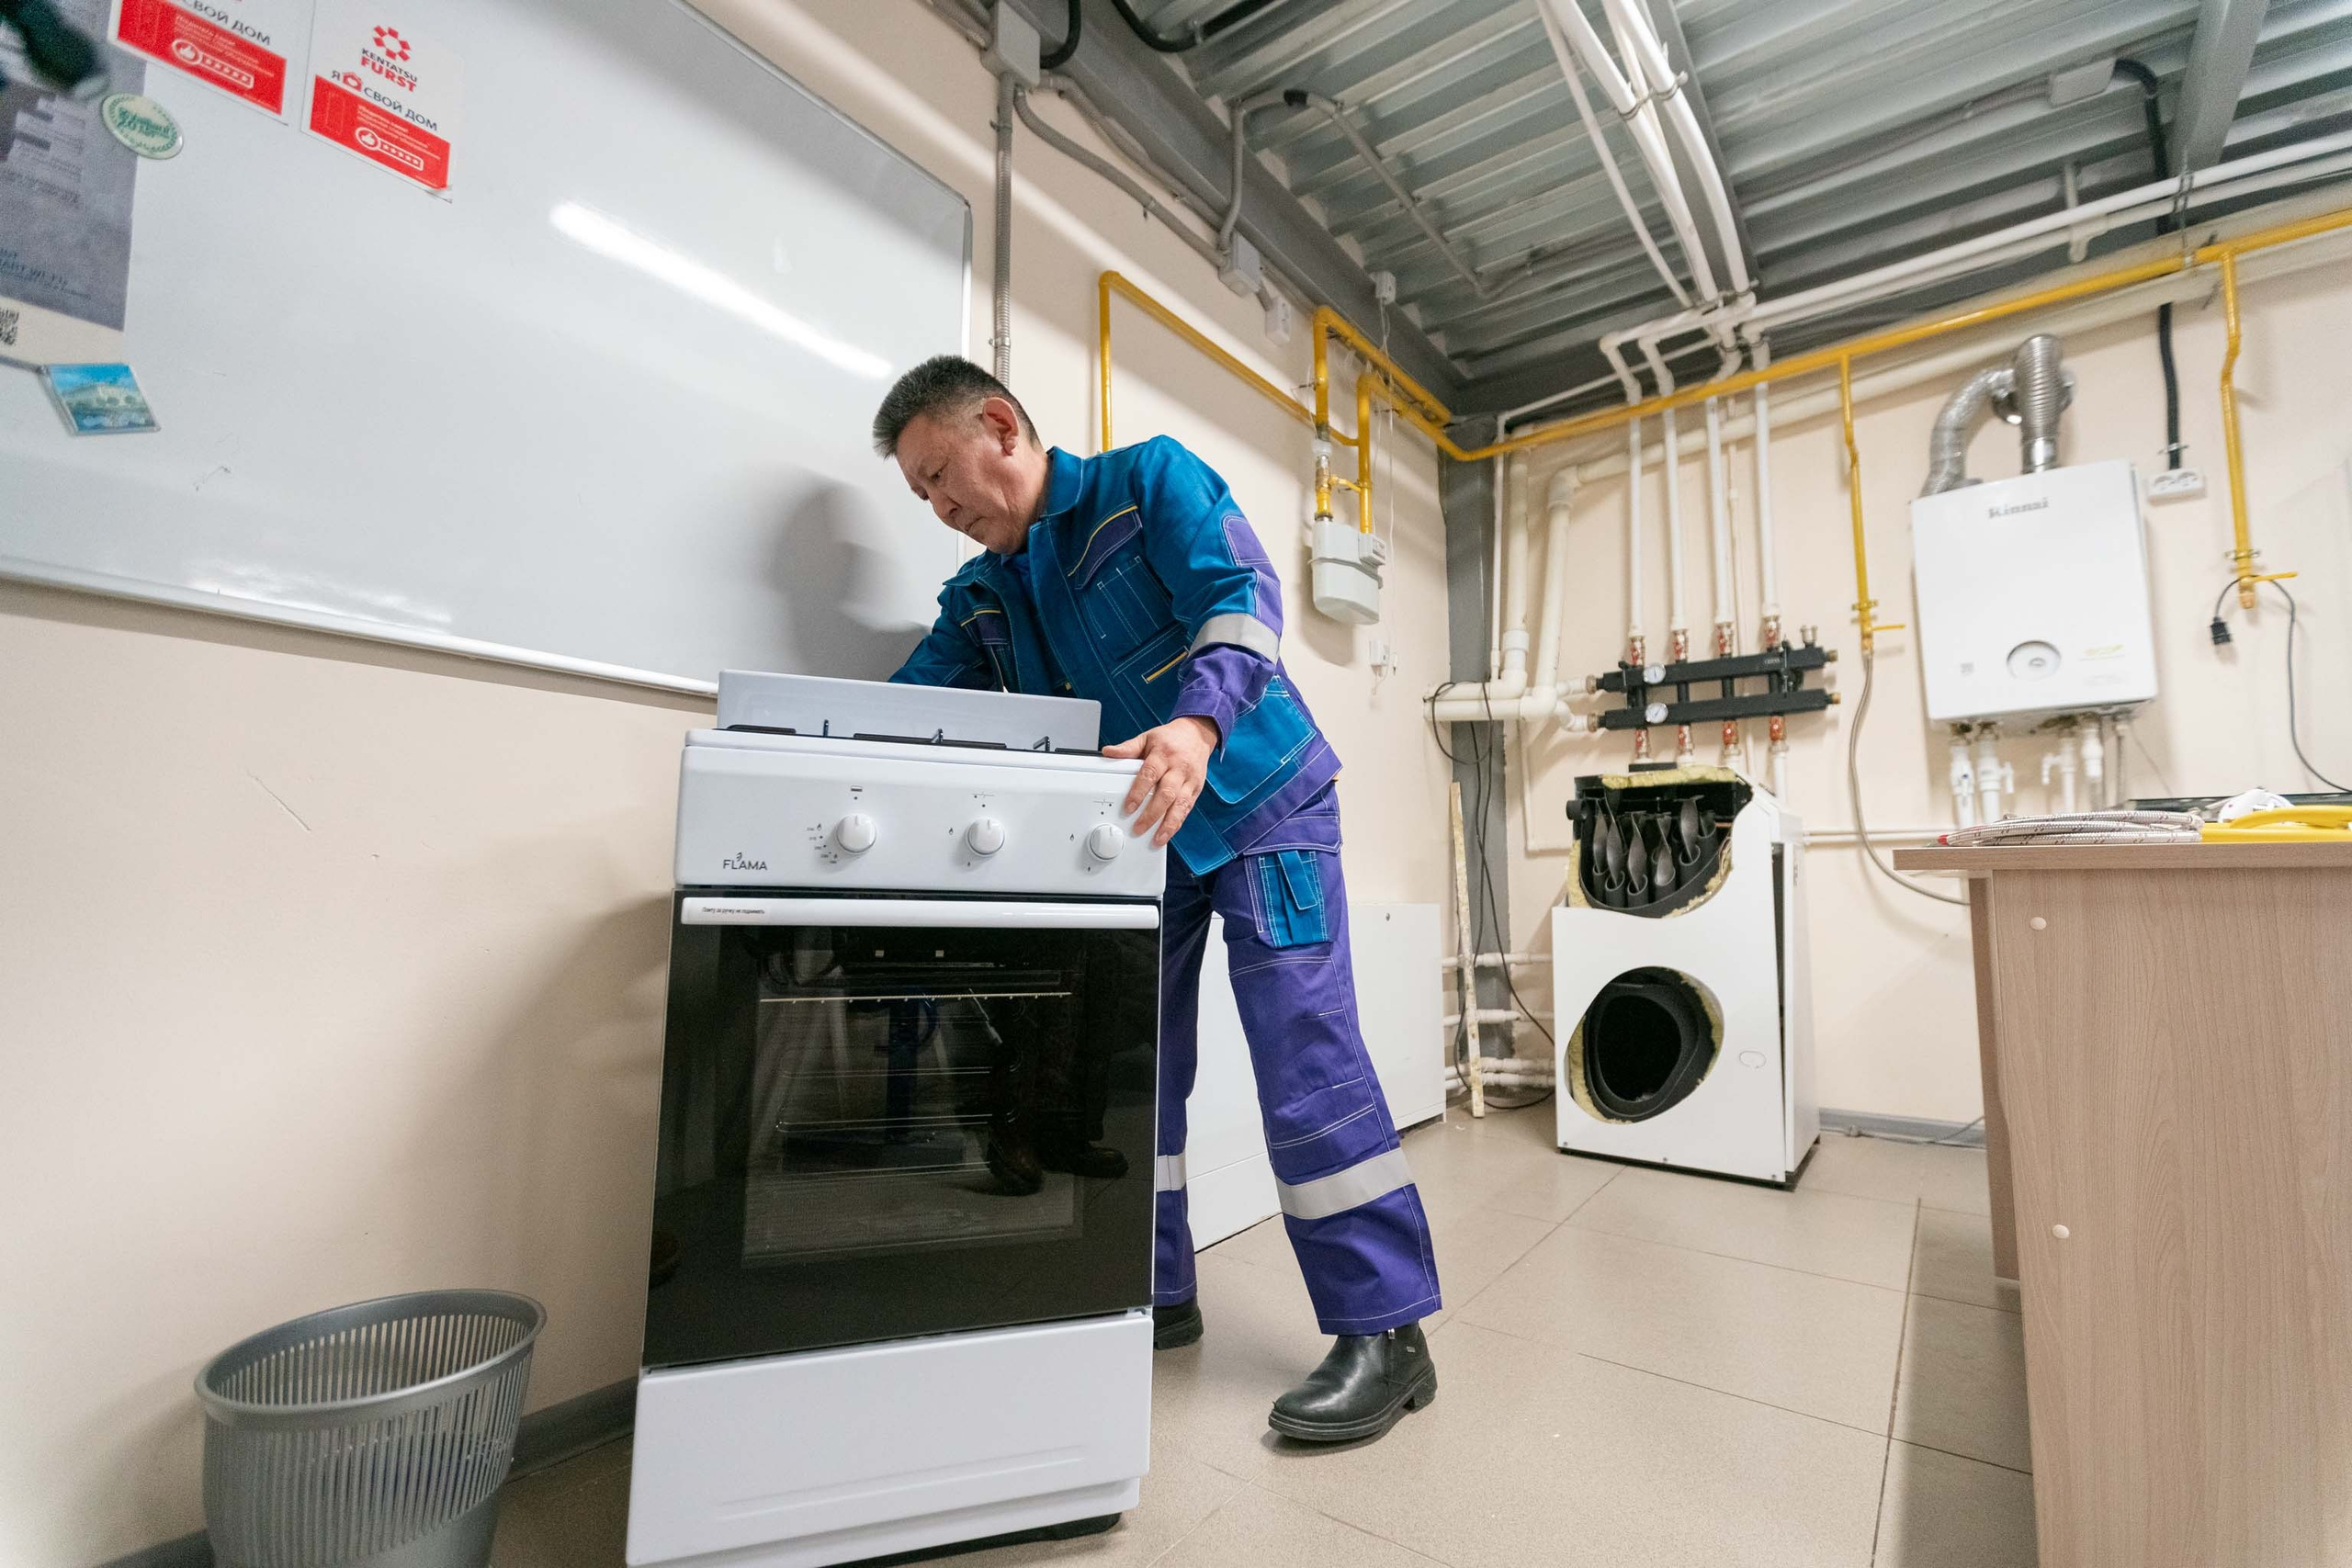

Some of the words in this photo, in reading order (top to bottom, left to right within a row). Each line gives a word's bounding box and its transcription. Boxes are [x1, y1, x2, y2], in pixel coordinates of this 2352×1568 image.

[232, 19, 271, 46] ДОМ
[360, 55, 417, 93] FURST
[361, 48, 418, 83] KENTATSU
[331, 70, 341, 82] Я
[364, 87, 403, 114] СВОЙ
[404, 108, 438, 131] ДОМ
[1988, 497, 2049, 518] Rinnai
[722, 859, 768, 871] FLAMA
